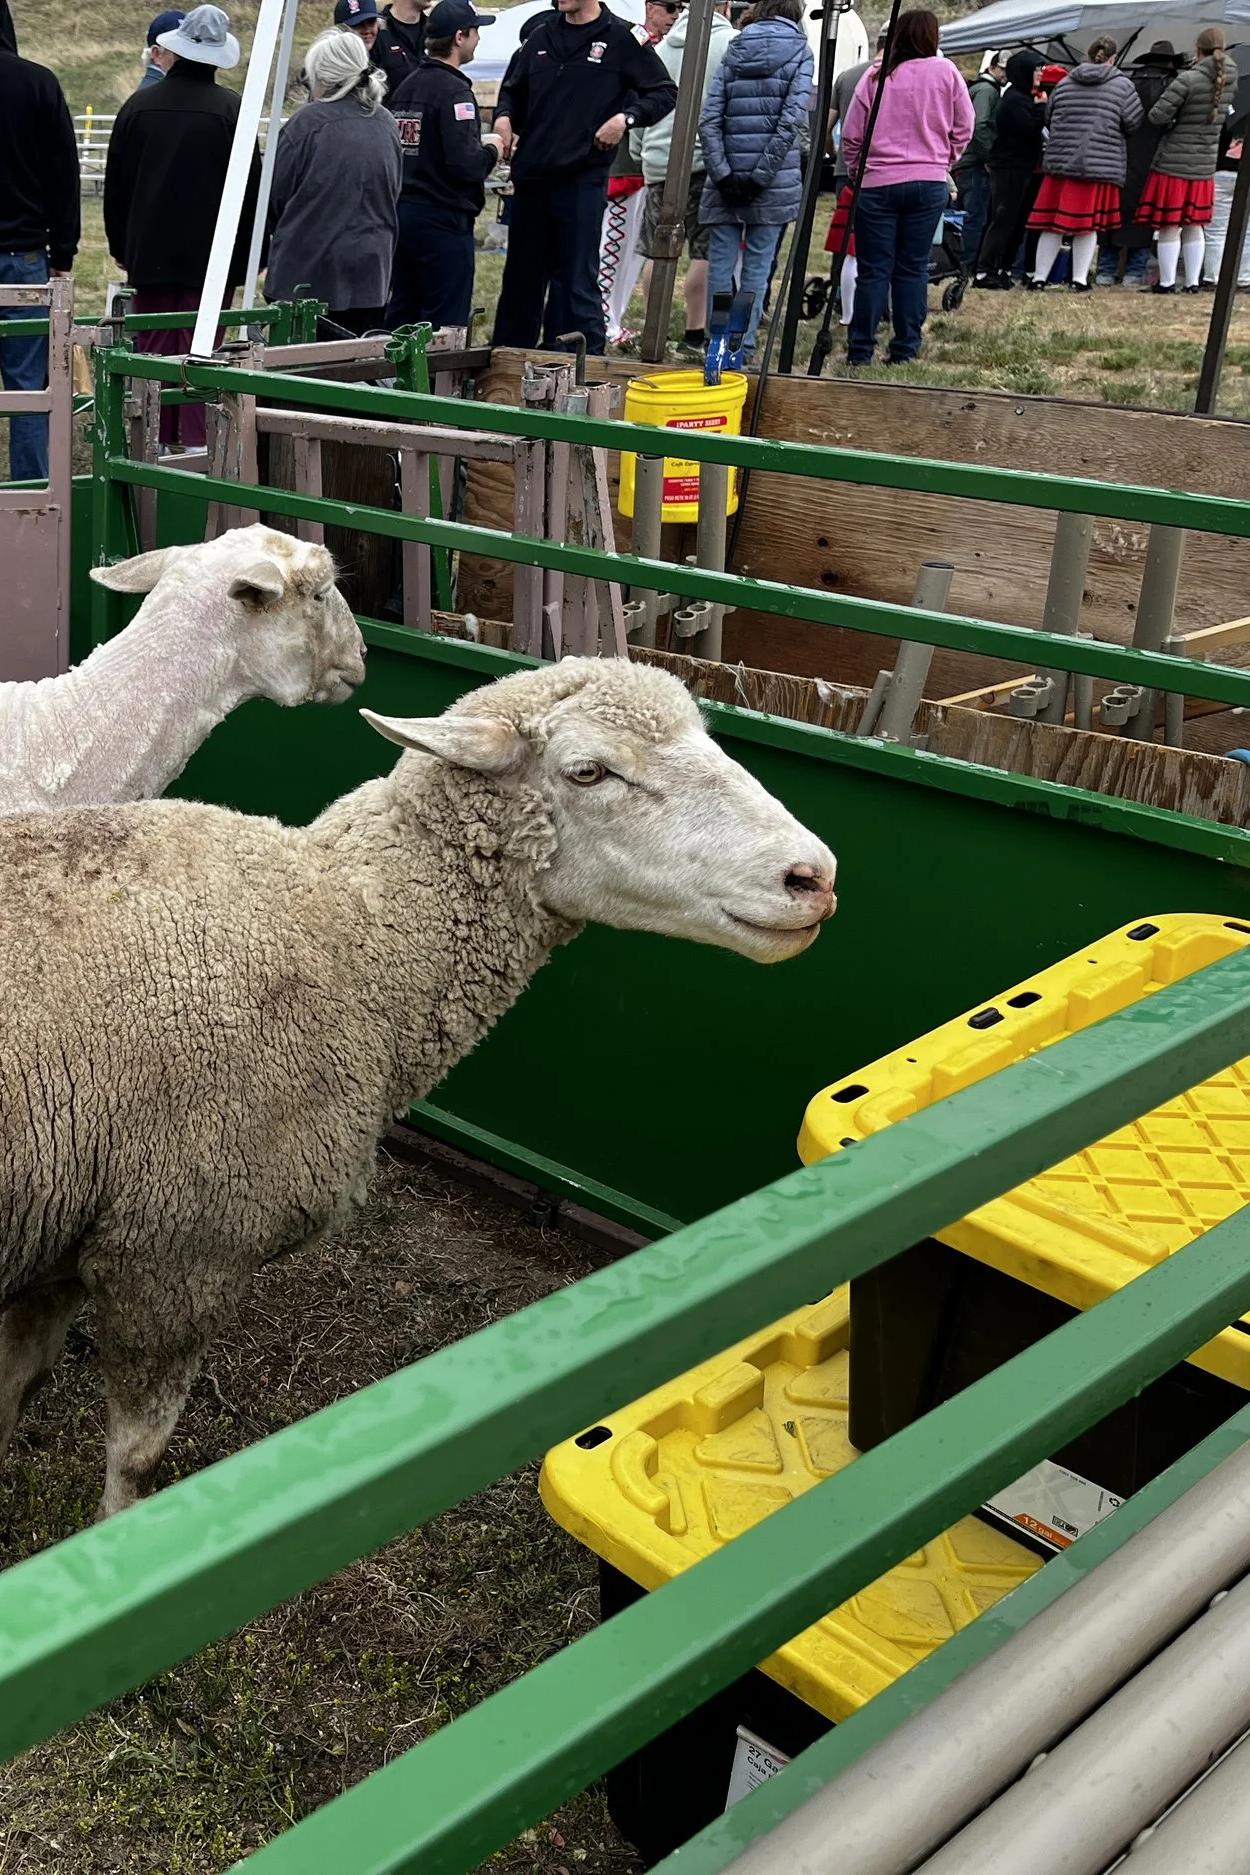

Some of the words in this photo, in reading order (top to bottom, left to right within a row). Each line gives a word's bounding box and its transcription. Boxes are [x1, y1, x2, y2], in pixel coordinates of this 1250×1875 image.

[1023, 1516, 1038, 1530] 12
[1038, 1527, 1053, 1539] gal
[749, 1746, 761, 1758] 27
[748, 1757, 766, 1775] Caja
